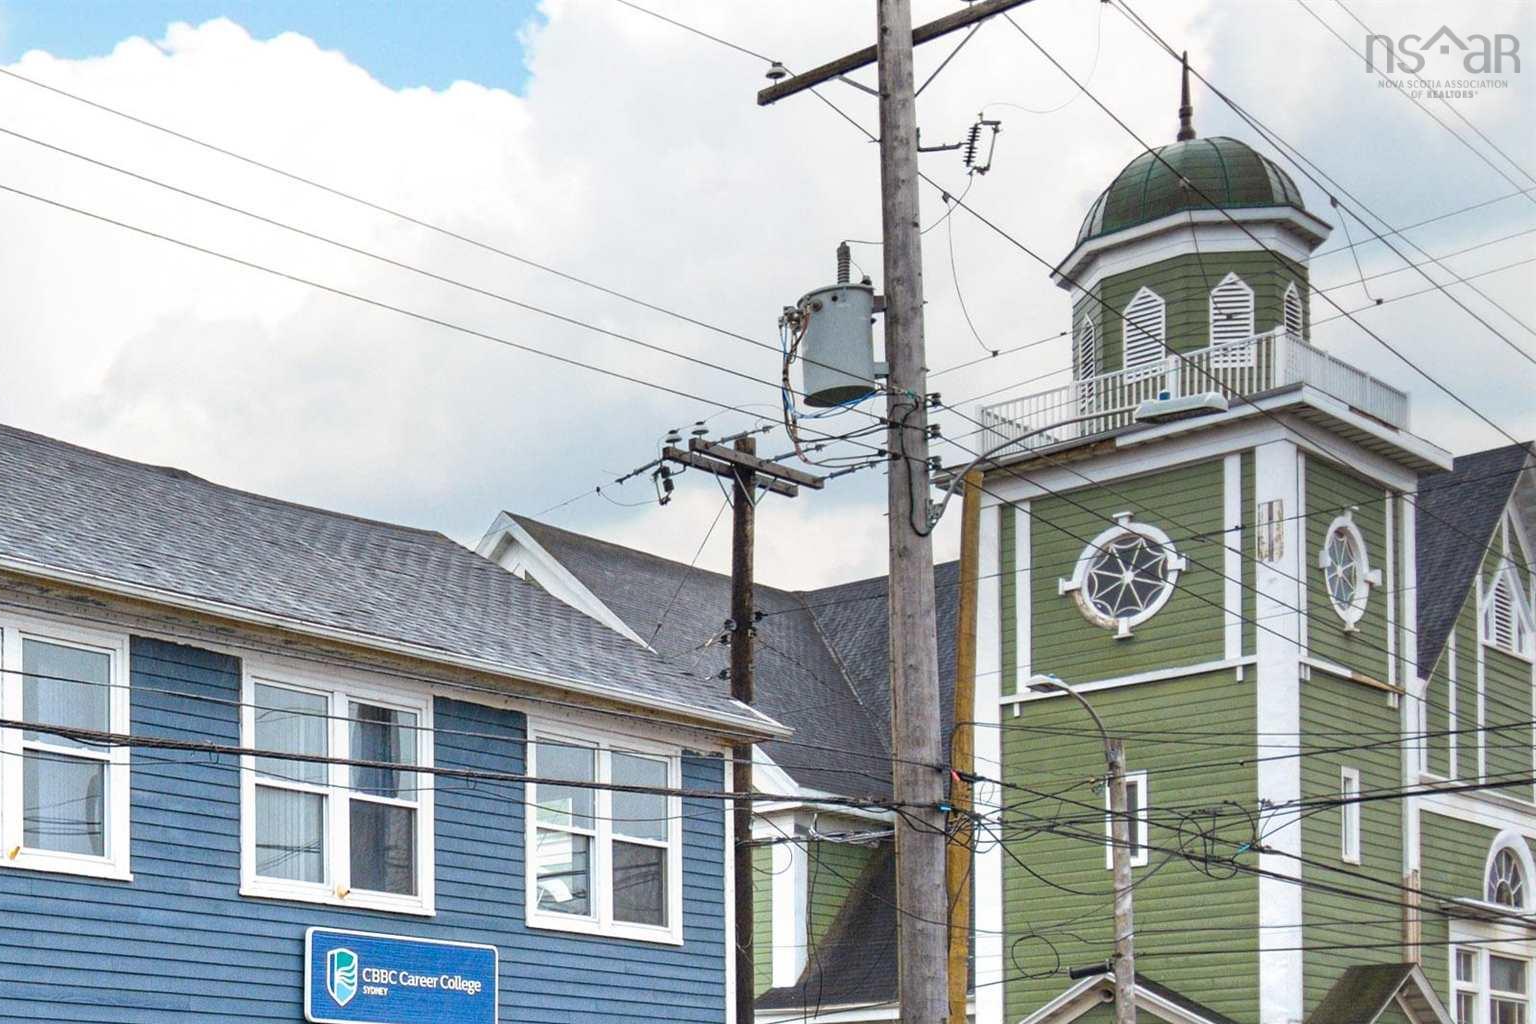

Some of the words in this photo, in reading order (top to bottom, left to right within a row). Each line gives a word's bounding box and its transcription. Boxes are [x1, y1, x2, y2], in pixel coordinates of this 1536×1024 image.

[362, 967, 398, 985] CBBC
[399, 971, 438, 988] Career
[440, 975, 482, 995] College
[362, 985, 389, 996] SYDNEY
